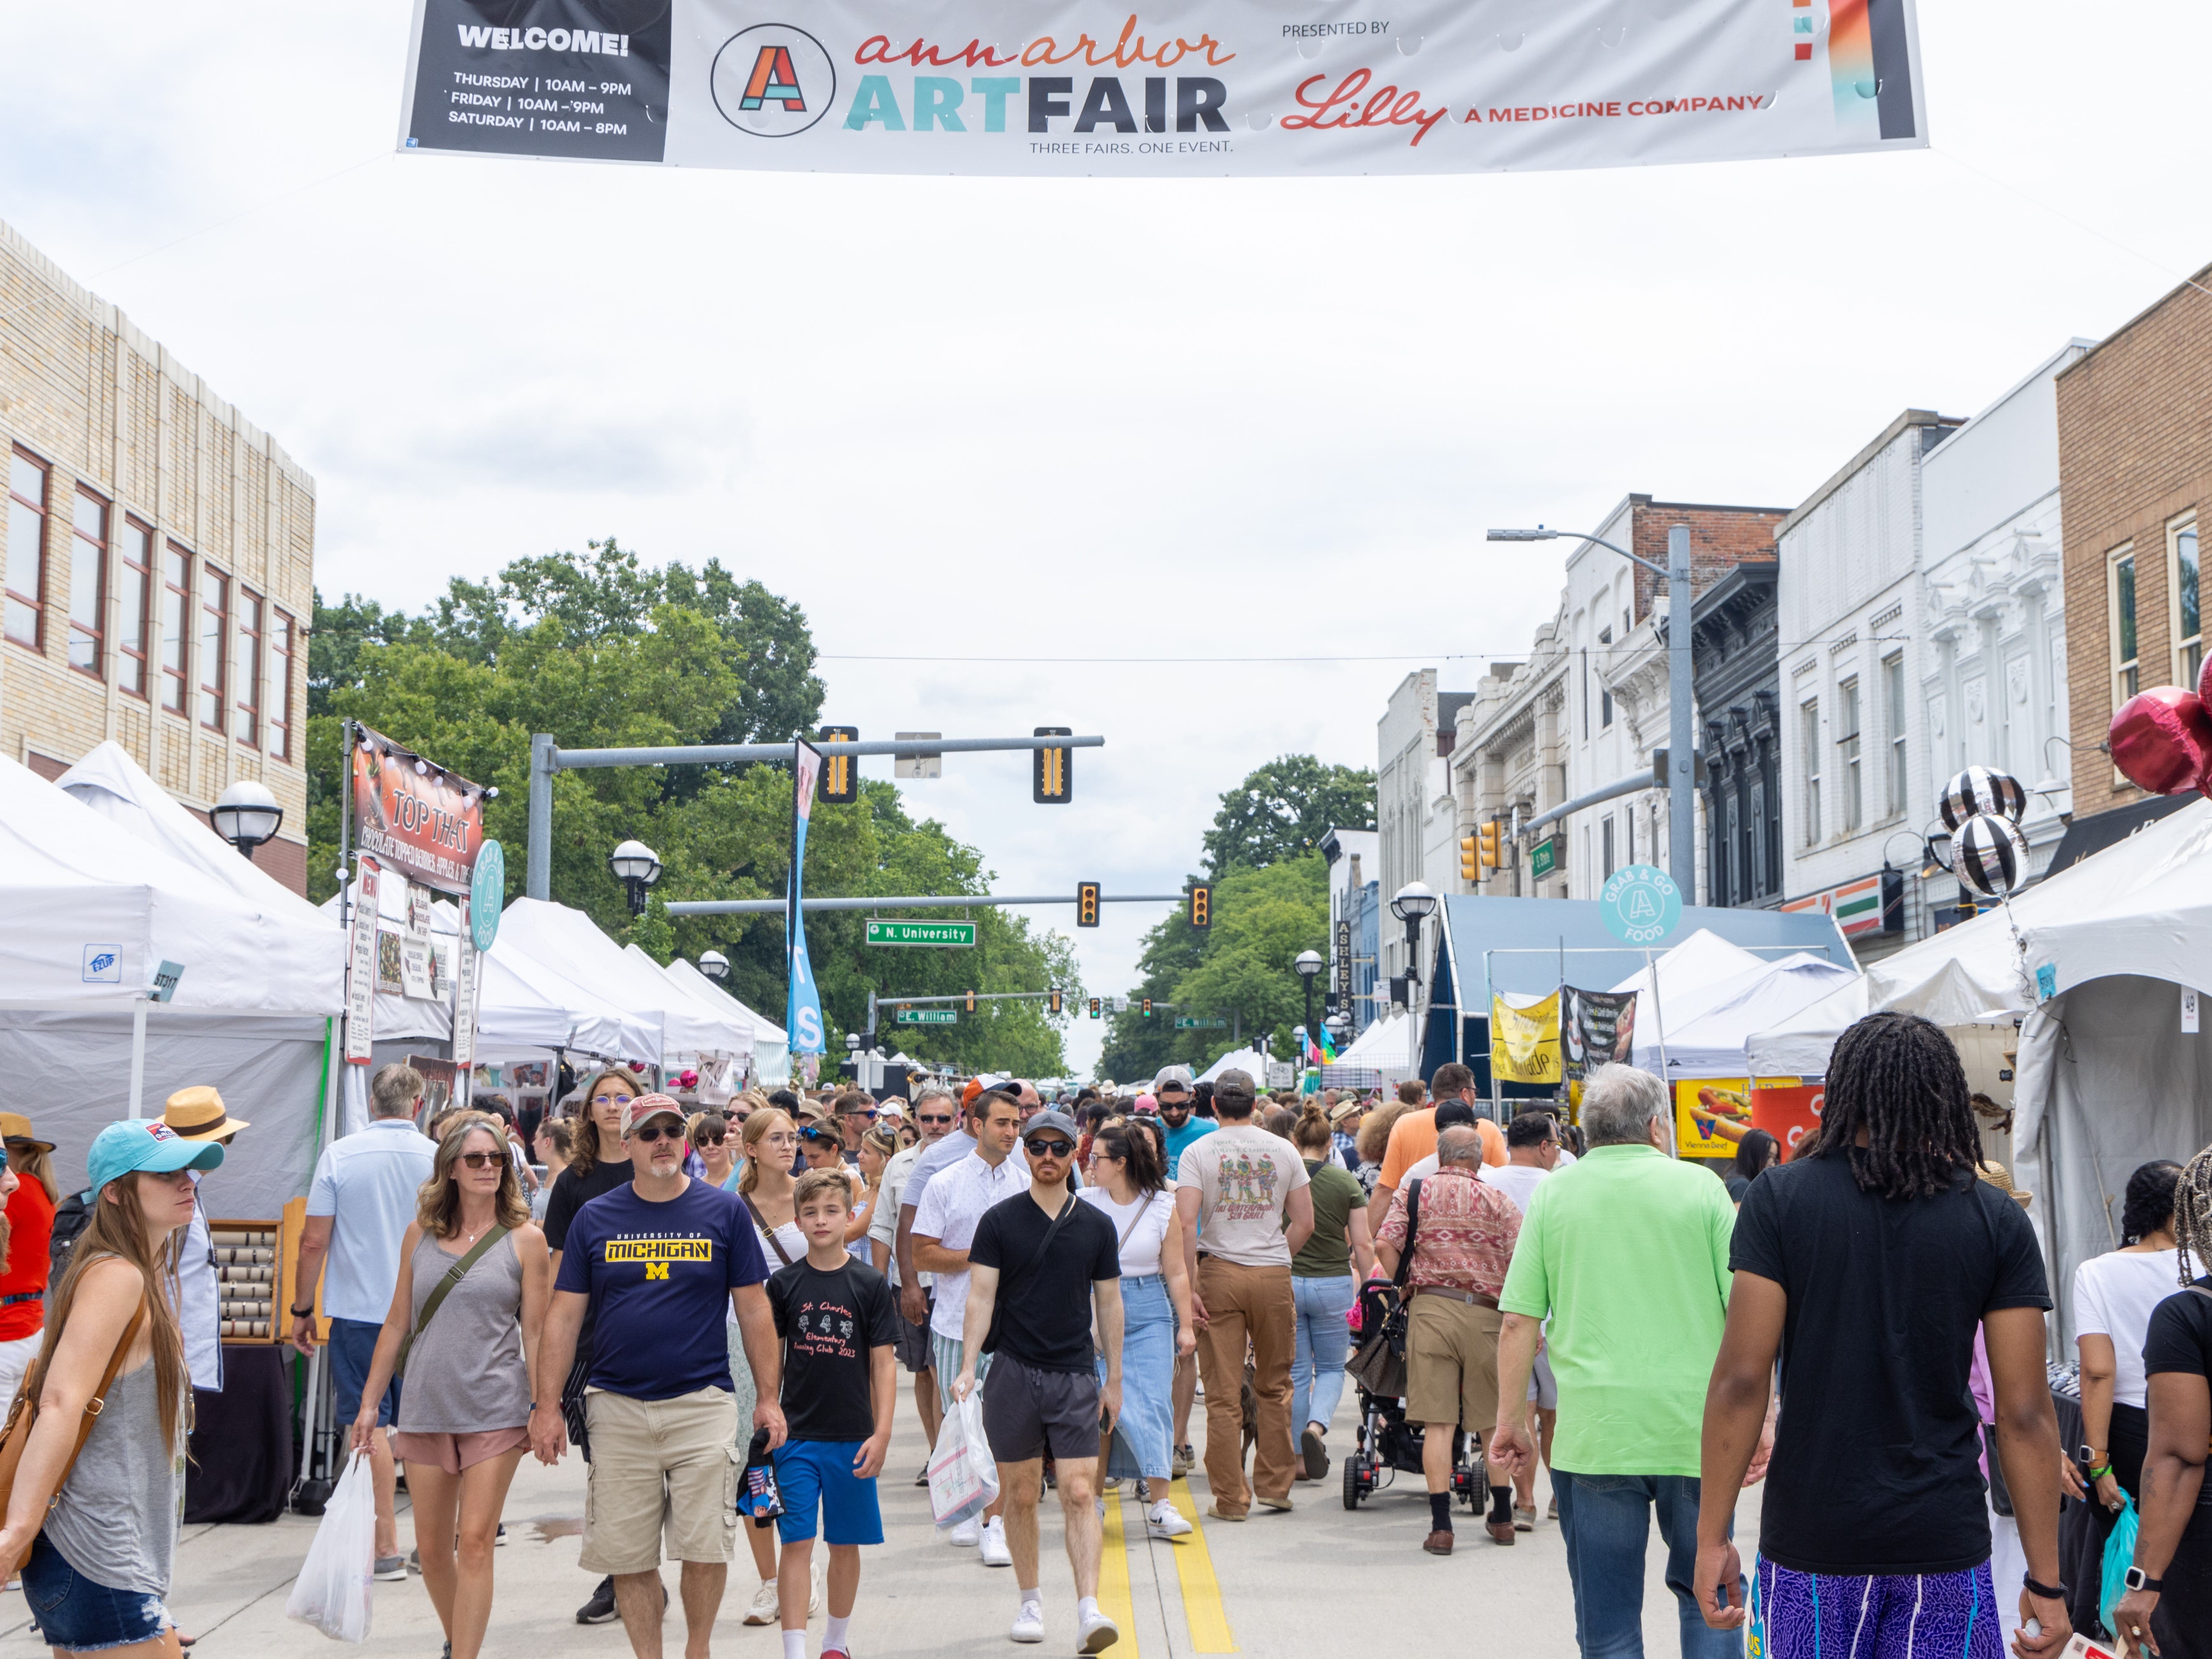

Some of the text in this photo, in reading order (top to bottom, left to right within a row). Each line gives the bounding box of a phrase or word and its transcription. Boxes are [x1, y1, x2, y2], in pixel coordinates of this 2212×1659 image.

[1282, 21, 1389, 37] PRESENTED BY
[457, 24, 629, 57] WELCOME!
[454, 72, 529, 89] THURSDAY
[545, 79, 585, 93] 10AM
[600, 82, 631, 95] 9PM
[451, 91, 501, 108] FRIDAY
[517, 98, 557, 112] 10AM
[573, 101, 604, 114] 9PM
[1280, 68, 1448, 147] Lilly
[1464, 95, 1764, 123] A MEDICINE COMPANY
[448, 111, 524, 128] SATURDAY
[540, 119, 580, 132] 10AM
[596, 123, 627, 135] 8PM
[1030, 140, 1233, 154] THREE FAIRS. ONE EVENT.
[393, 788, 470, 853] TOP THAT
[361, 825, 395, 857] CHOCOLATE
[394, 839, 415, 863] TOPPED
[415, 847, 437, 873] BERRIES,
[437, 856, 455, 880] APPLES,
[477, 847, 503, 888] GRAB & GO
[1606, 869, 1674, 902] GRAB & GO
[478, 925, 494, 946] FOOD
[886, 927, 966, 942] N. University
[1625, 925, 1664, 942] FOOD
[1338, 923, 1349, 1009] ASHLEY'S
[154, 973, 178, 989] ST317
[906, 1012, 955, 1021] E. William
[1711, 1141, 1727, 1151] Beef
[608, 1242, 709, 1259] MICHIGAN
[646, 1262, 669, 1280] M
[801, 1301, 852, 1318] St. Charles
[806, 1332, 846, 1347] Elementary
[794, 1342, 855, 1358] Running Club 2023
